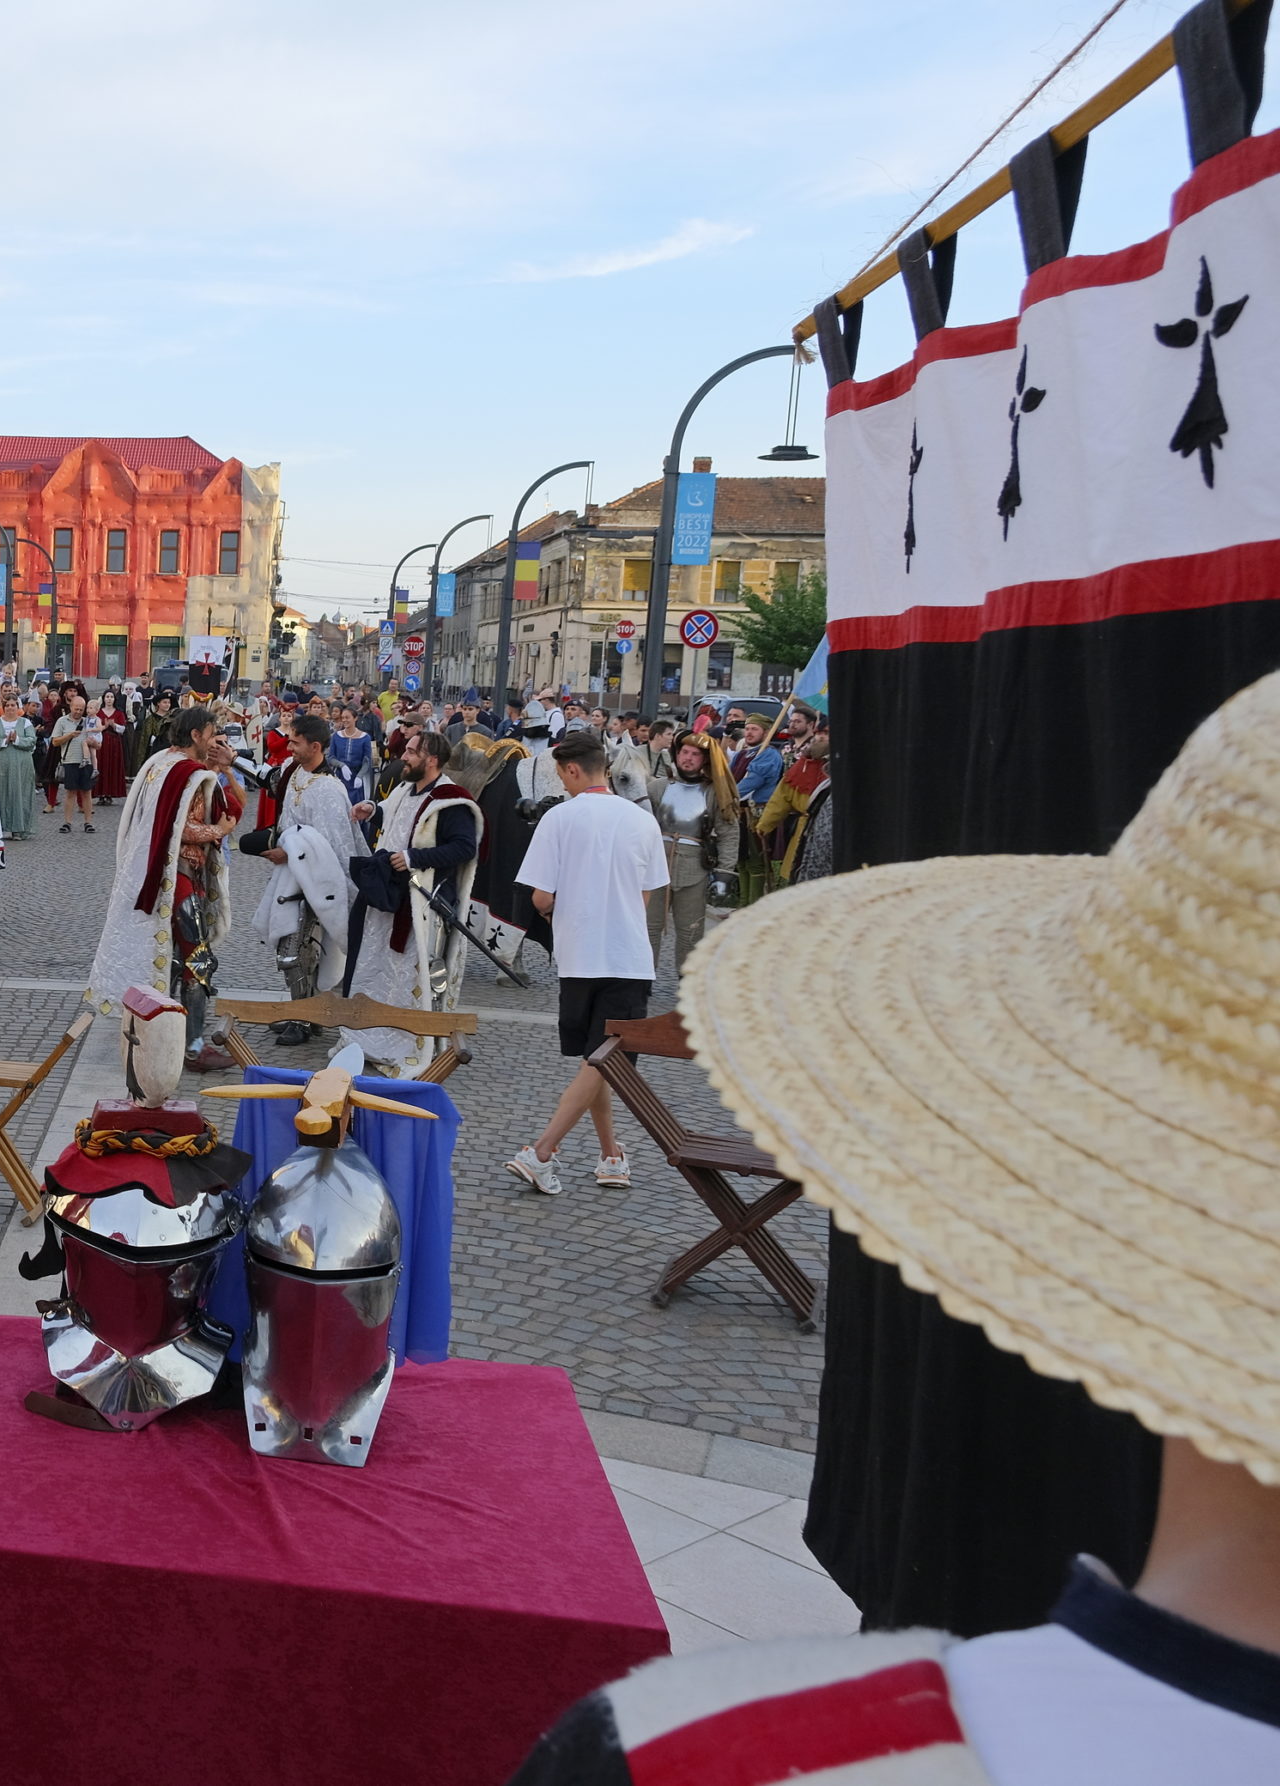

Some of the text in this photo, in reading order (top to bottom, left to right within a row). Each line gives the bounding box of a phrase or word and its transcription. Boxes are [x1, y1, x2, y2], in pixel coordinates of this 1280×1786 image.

[679, 520, 709, 530] BEST
[677, 535, 709, 547] 2022
[616, 625, 635, 634] STOP
[404, 642, 424, 652] STOP
